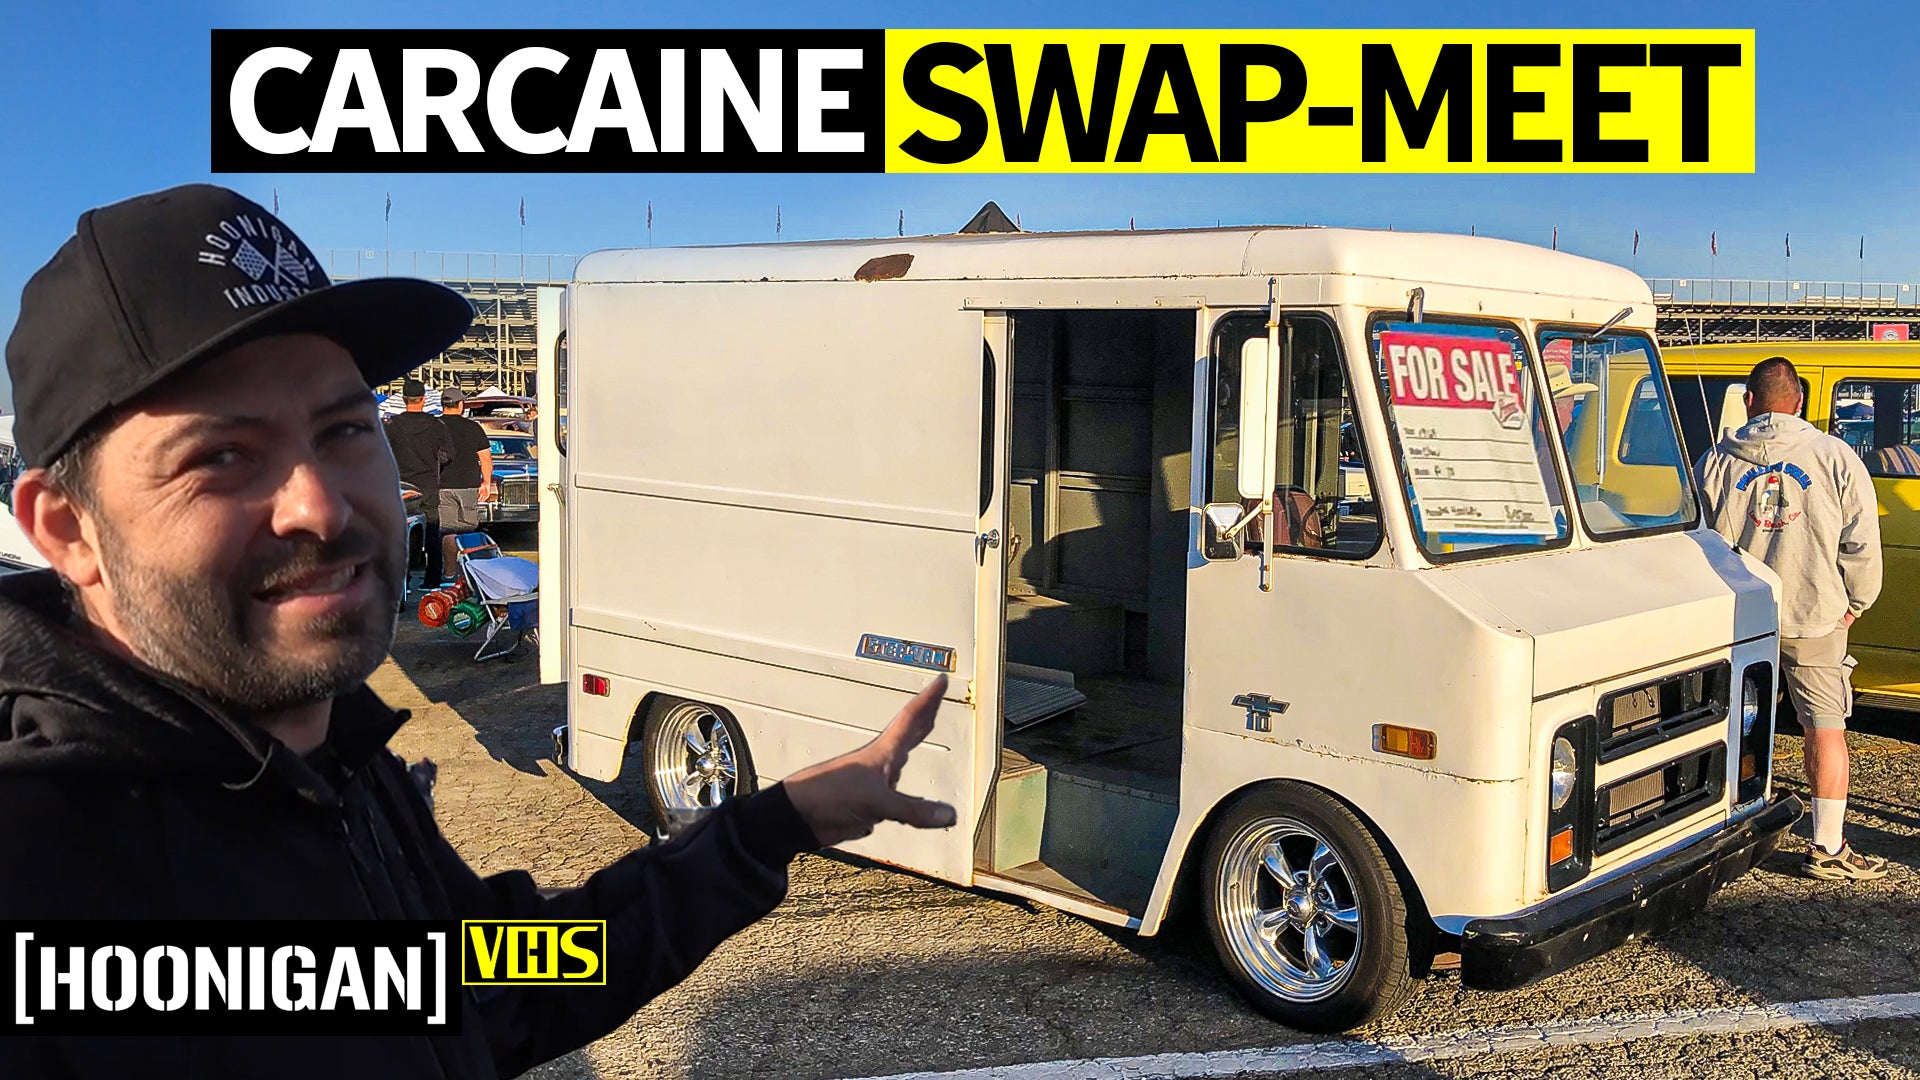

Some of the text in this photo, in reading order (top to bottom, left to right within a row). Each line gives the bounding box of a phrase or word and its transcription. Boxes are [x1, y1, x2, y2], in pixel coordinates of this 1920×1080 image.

[198, 214, 315, 272] HOONIGAN
[223, 283, 312, 309] INDUST
[1387, 344, 1519, 403] FOR SALE
[1245, 711, 1273, 733] 10
